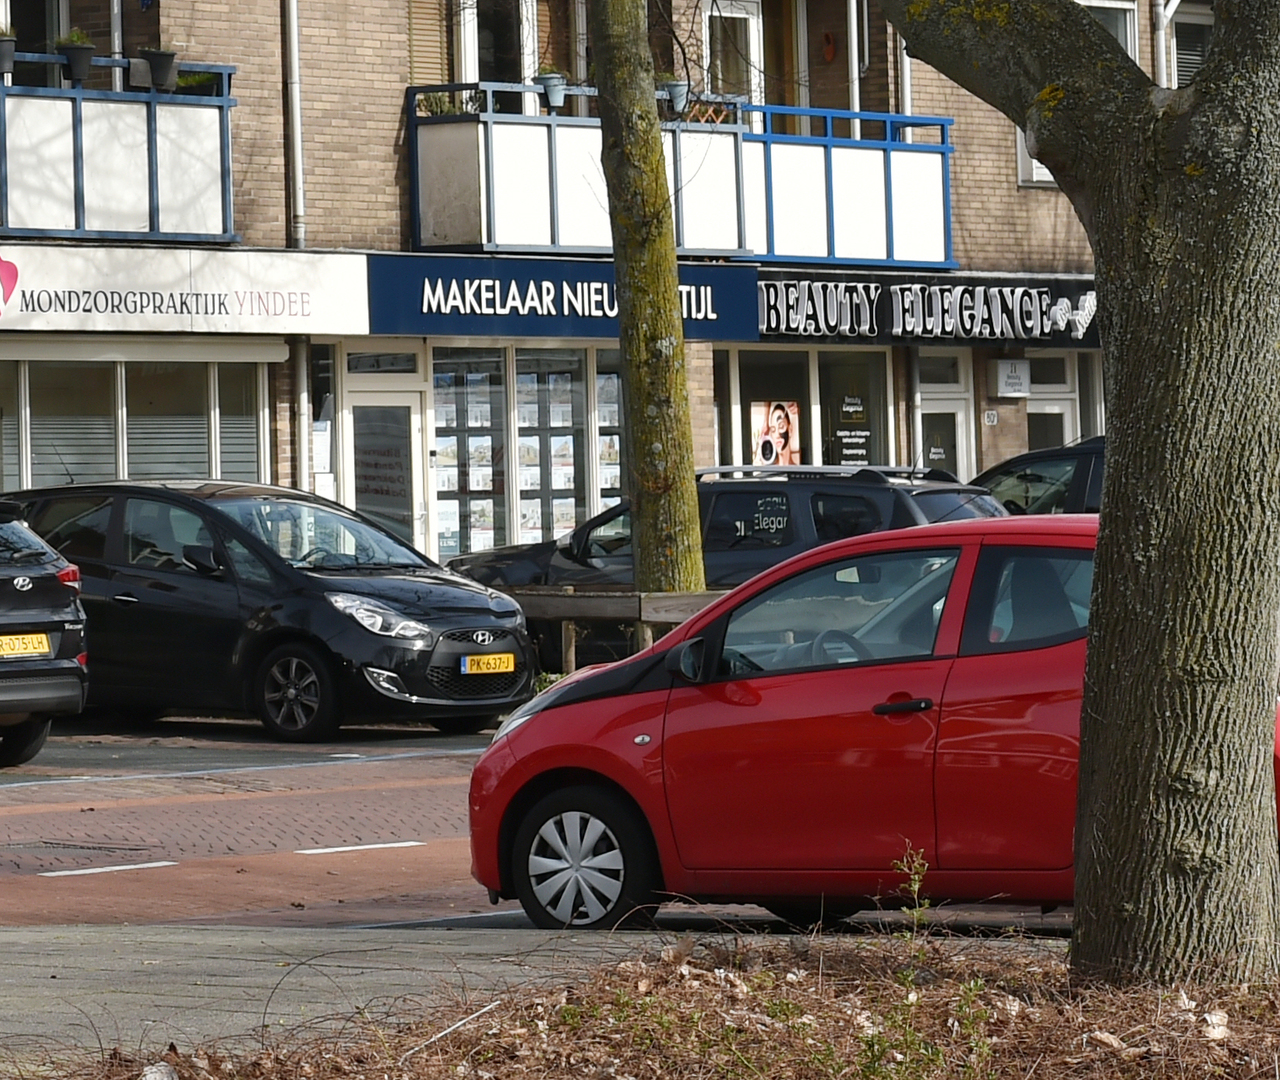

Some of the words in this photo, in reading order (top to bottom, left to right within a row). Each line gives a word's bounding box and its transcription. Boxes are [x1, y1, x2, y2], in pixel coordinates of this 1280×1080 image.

[19, 289, 231, 316] MONDZORGPRAKTIJK
[234, 290, 312, 318] YINDEE
[422, 277, 556, 316] MAKELAAR
[562, 280, 619, 318] NIEU
[677, 284, 718, 320] TIJL
[757, 280, 882, 337] BEAUTY
[890, 283, 1052, 339] ELEGANCE
[469, 656, 510, 672] PK-637-J
